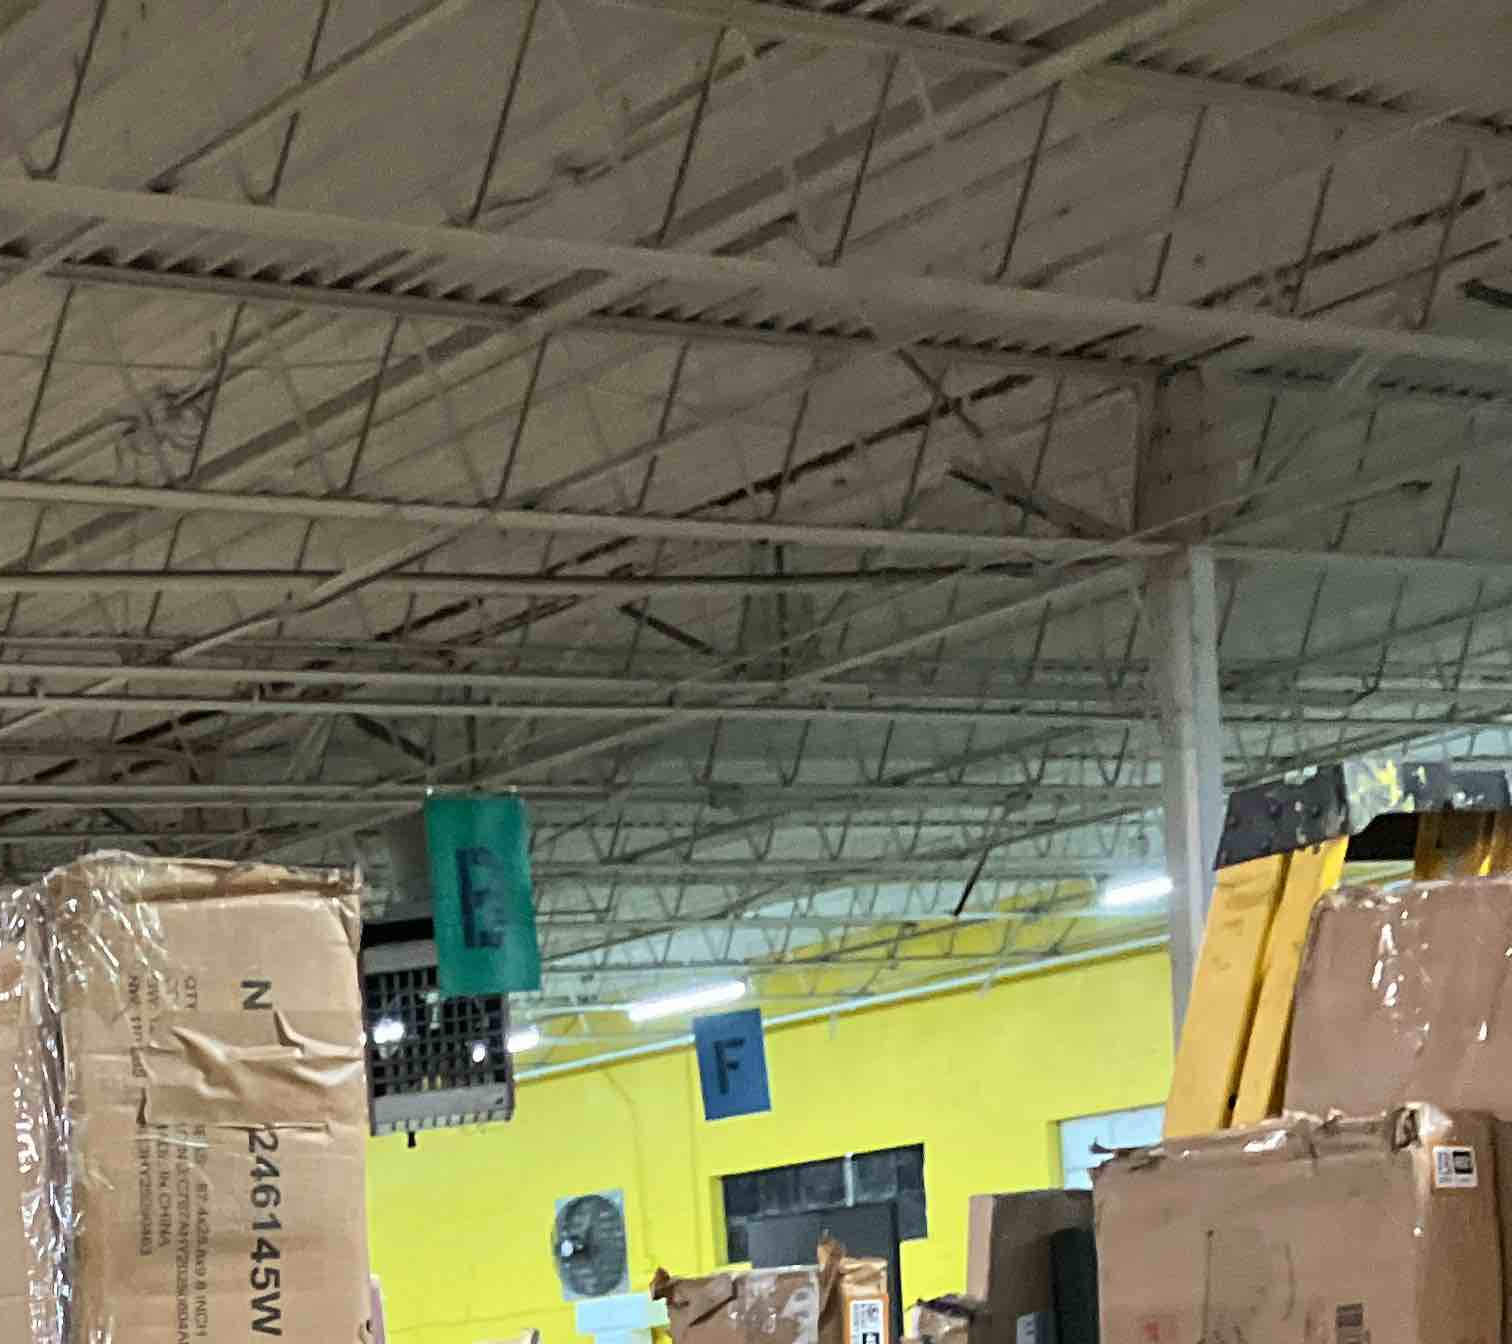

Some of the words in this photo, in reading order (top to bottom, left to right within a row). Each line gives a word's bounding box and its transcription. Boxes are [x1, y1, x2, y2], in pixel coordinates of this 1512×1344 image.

[455, 845, 505, 951] E
[712, 1036, 747, 1096] F
[247, 1127, 284, 1338] 246145W
